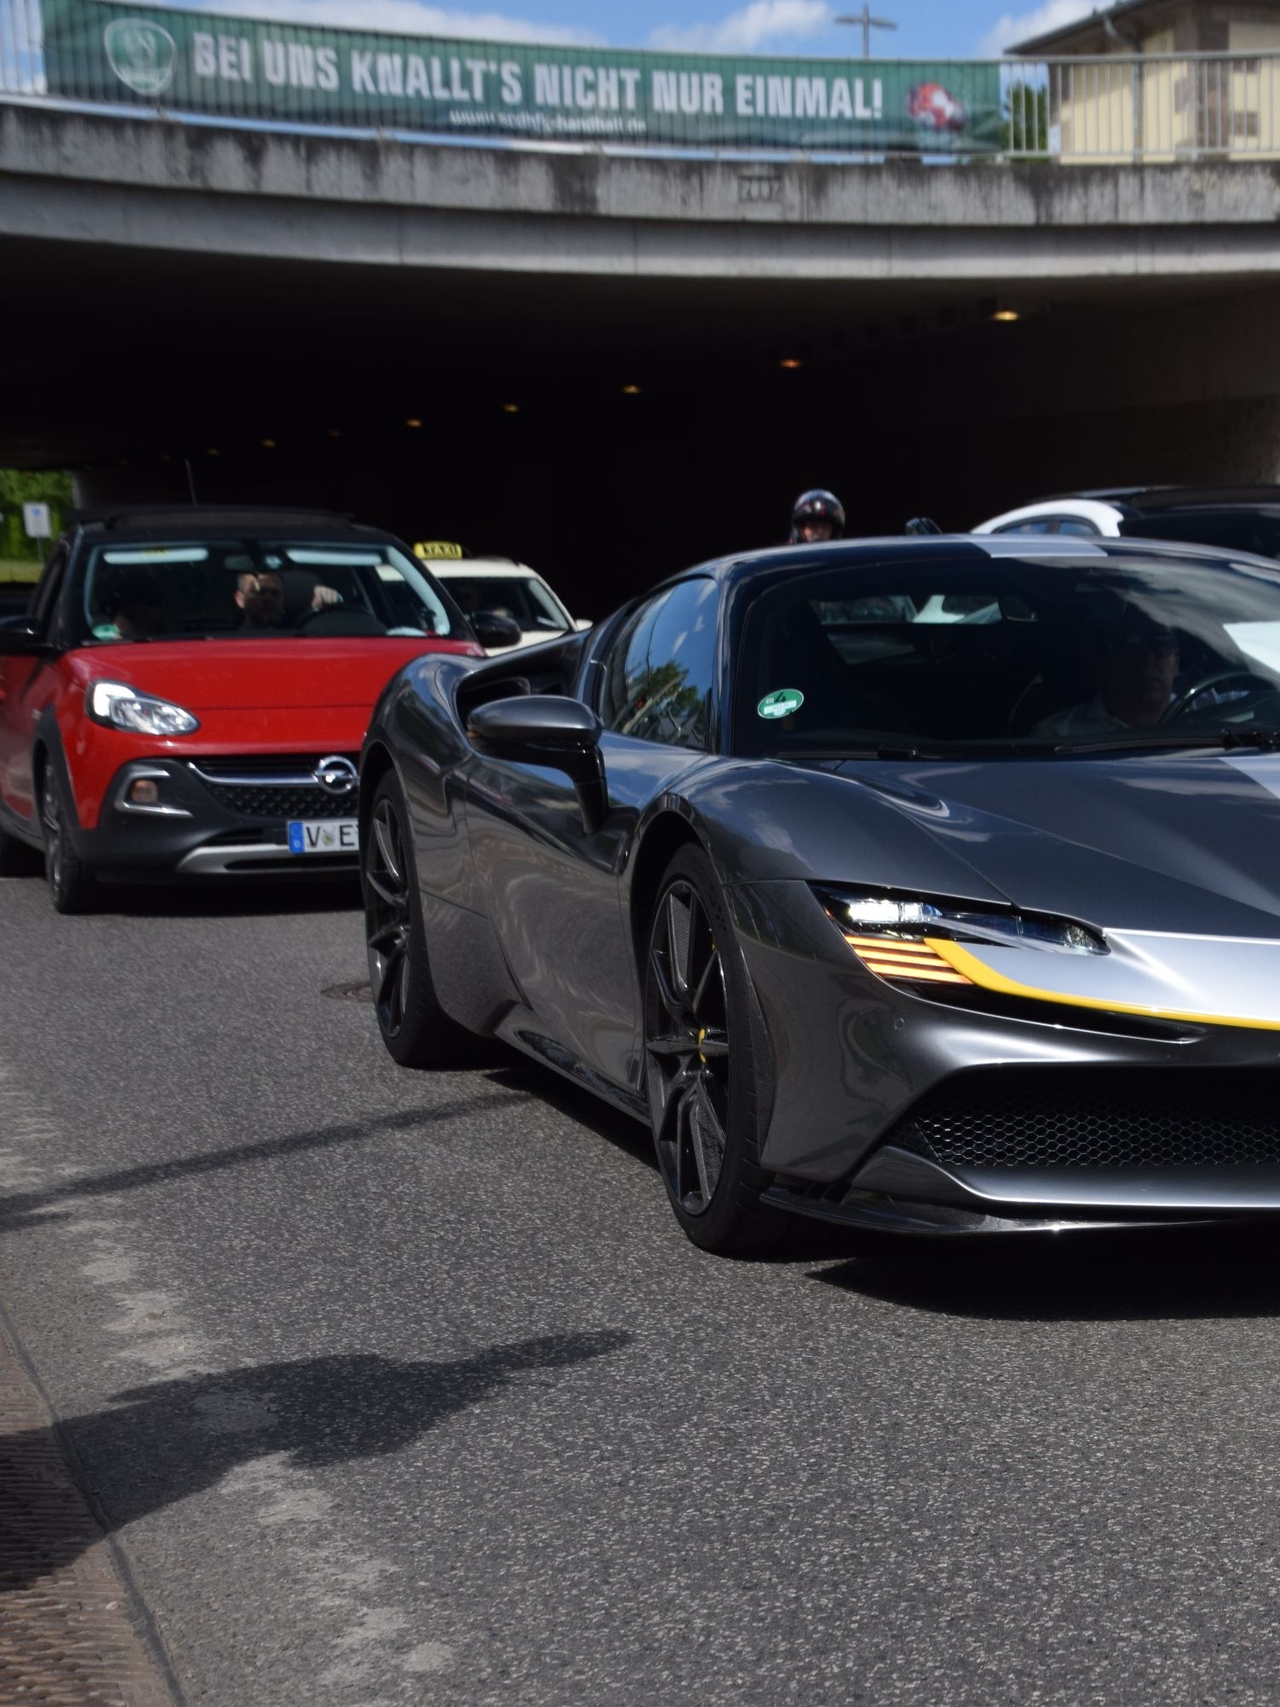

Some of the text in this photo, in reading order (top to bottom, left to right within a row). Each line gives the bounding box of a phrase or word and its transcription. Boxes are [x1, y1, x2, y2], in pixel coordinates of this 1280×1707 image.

[193, 32, 883, 120] BEI UNS KNALLT'S NICHT NUR EINMAL!
[423, 543, 458, 557] TAXI
[306, 826, 321, 848] V
[339, 824, 358, 847] E
